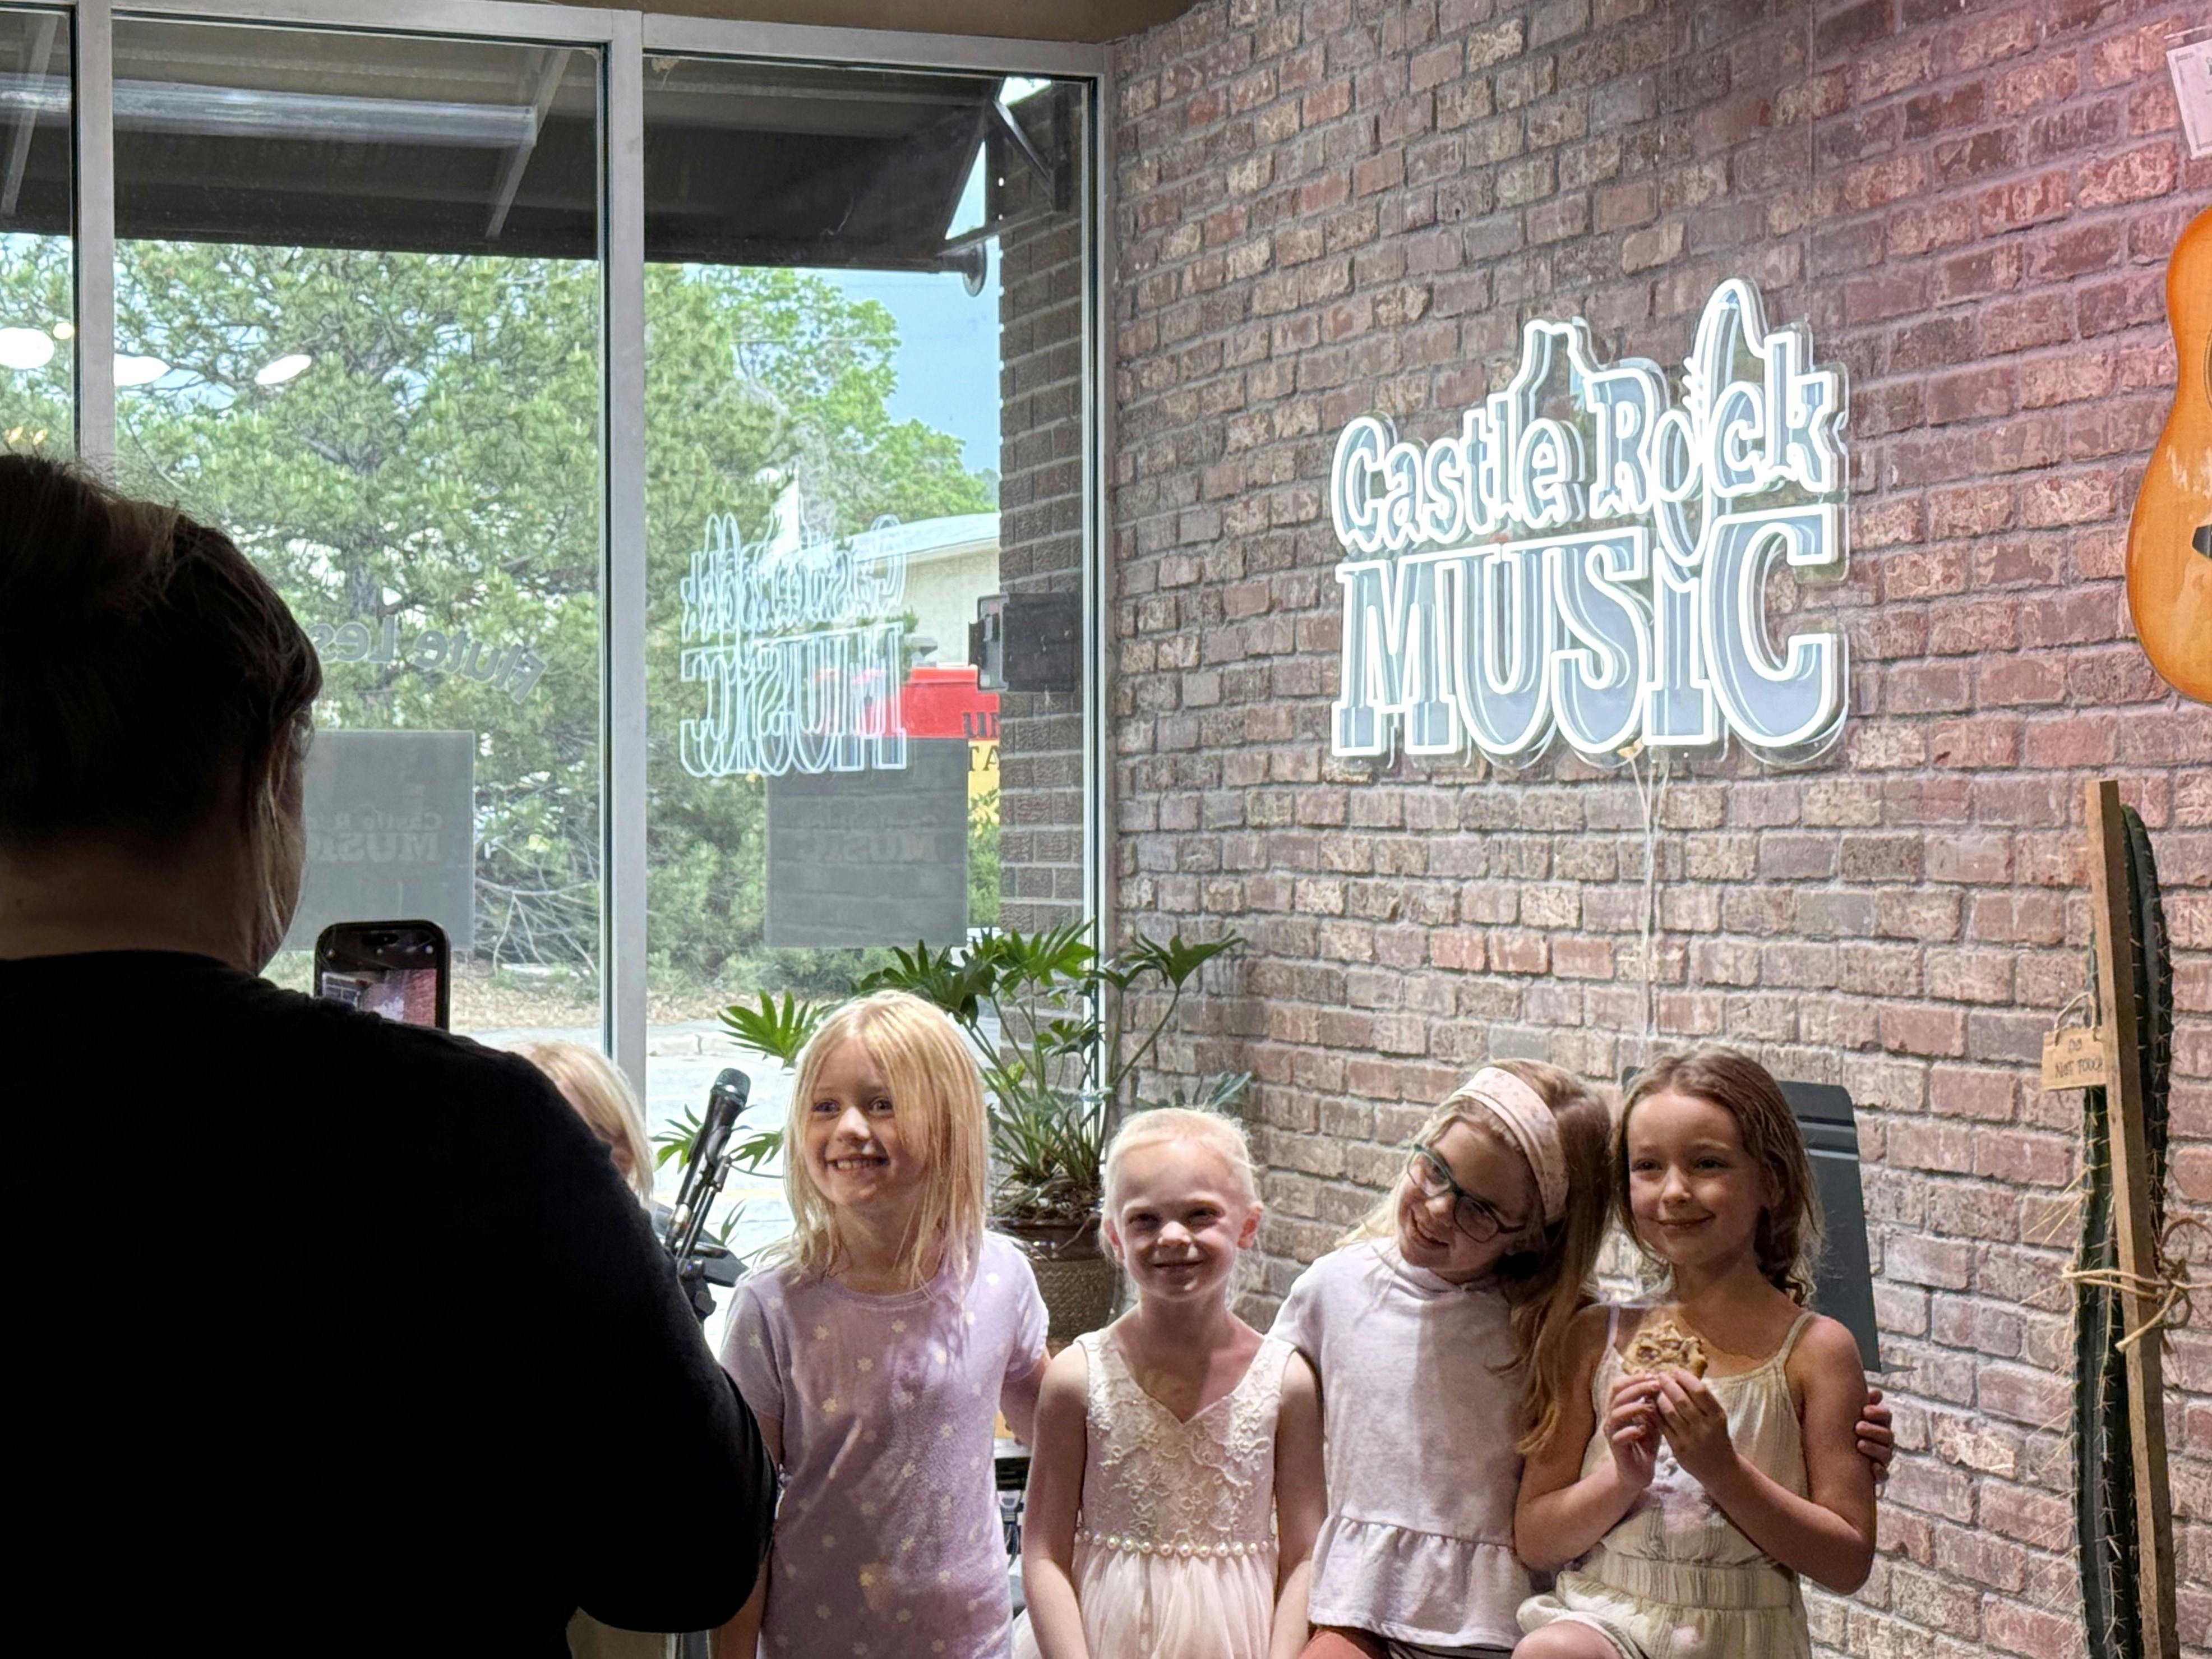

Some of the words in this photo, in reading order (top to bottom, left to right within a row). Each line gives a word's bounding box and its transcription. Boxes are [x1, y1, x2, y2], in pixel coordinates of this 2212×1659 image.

[1331, 381, 1573, 553] Castle
[1585, 325, 1837, 519] Rock
[1331, 503, 1838, 756] MUSIC
